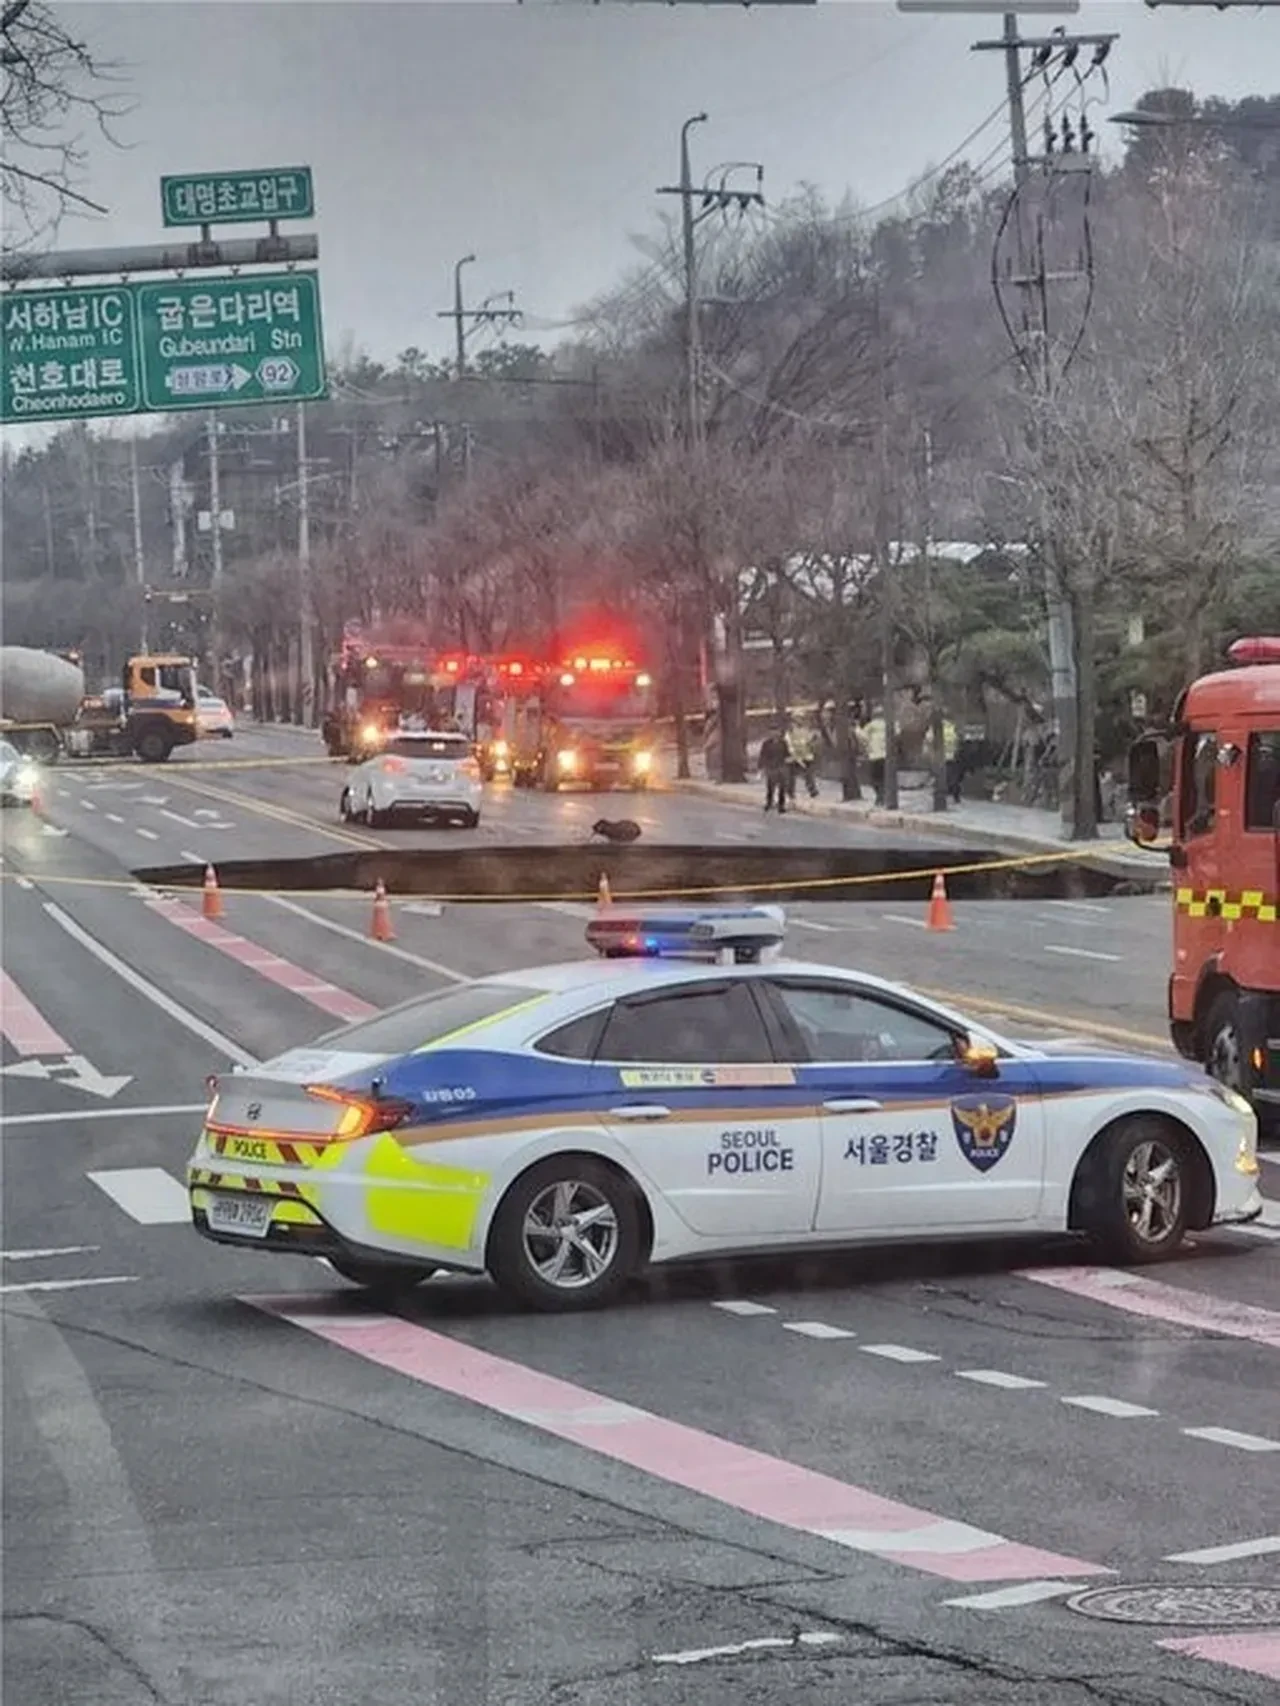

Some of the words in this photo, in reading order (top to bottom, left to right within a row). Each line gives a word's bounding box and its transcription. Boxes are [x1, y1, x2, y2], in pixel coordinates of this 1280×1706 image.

[175, 176, 298, 216] 대명초교입구
[5, 295, 123, 333] 서하남IC
[156, 287, 300, 331] 굽은다리역
[102, 327, 123, 345] IC
[159, 331, 256, 358] Gubeundari
[271, 328, 302, 350] Stn
[9, 358, 128, 394] 천호대로
[265, 364, 289, 383] 92
[11, 391, 126, 413] Cheonhodaero
[721, 1130, 781, 1150] SEOUL
[843, 1131, 938, 1166] 서울경찰
[707, 1148, 794, 1175] POLICE
